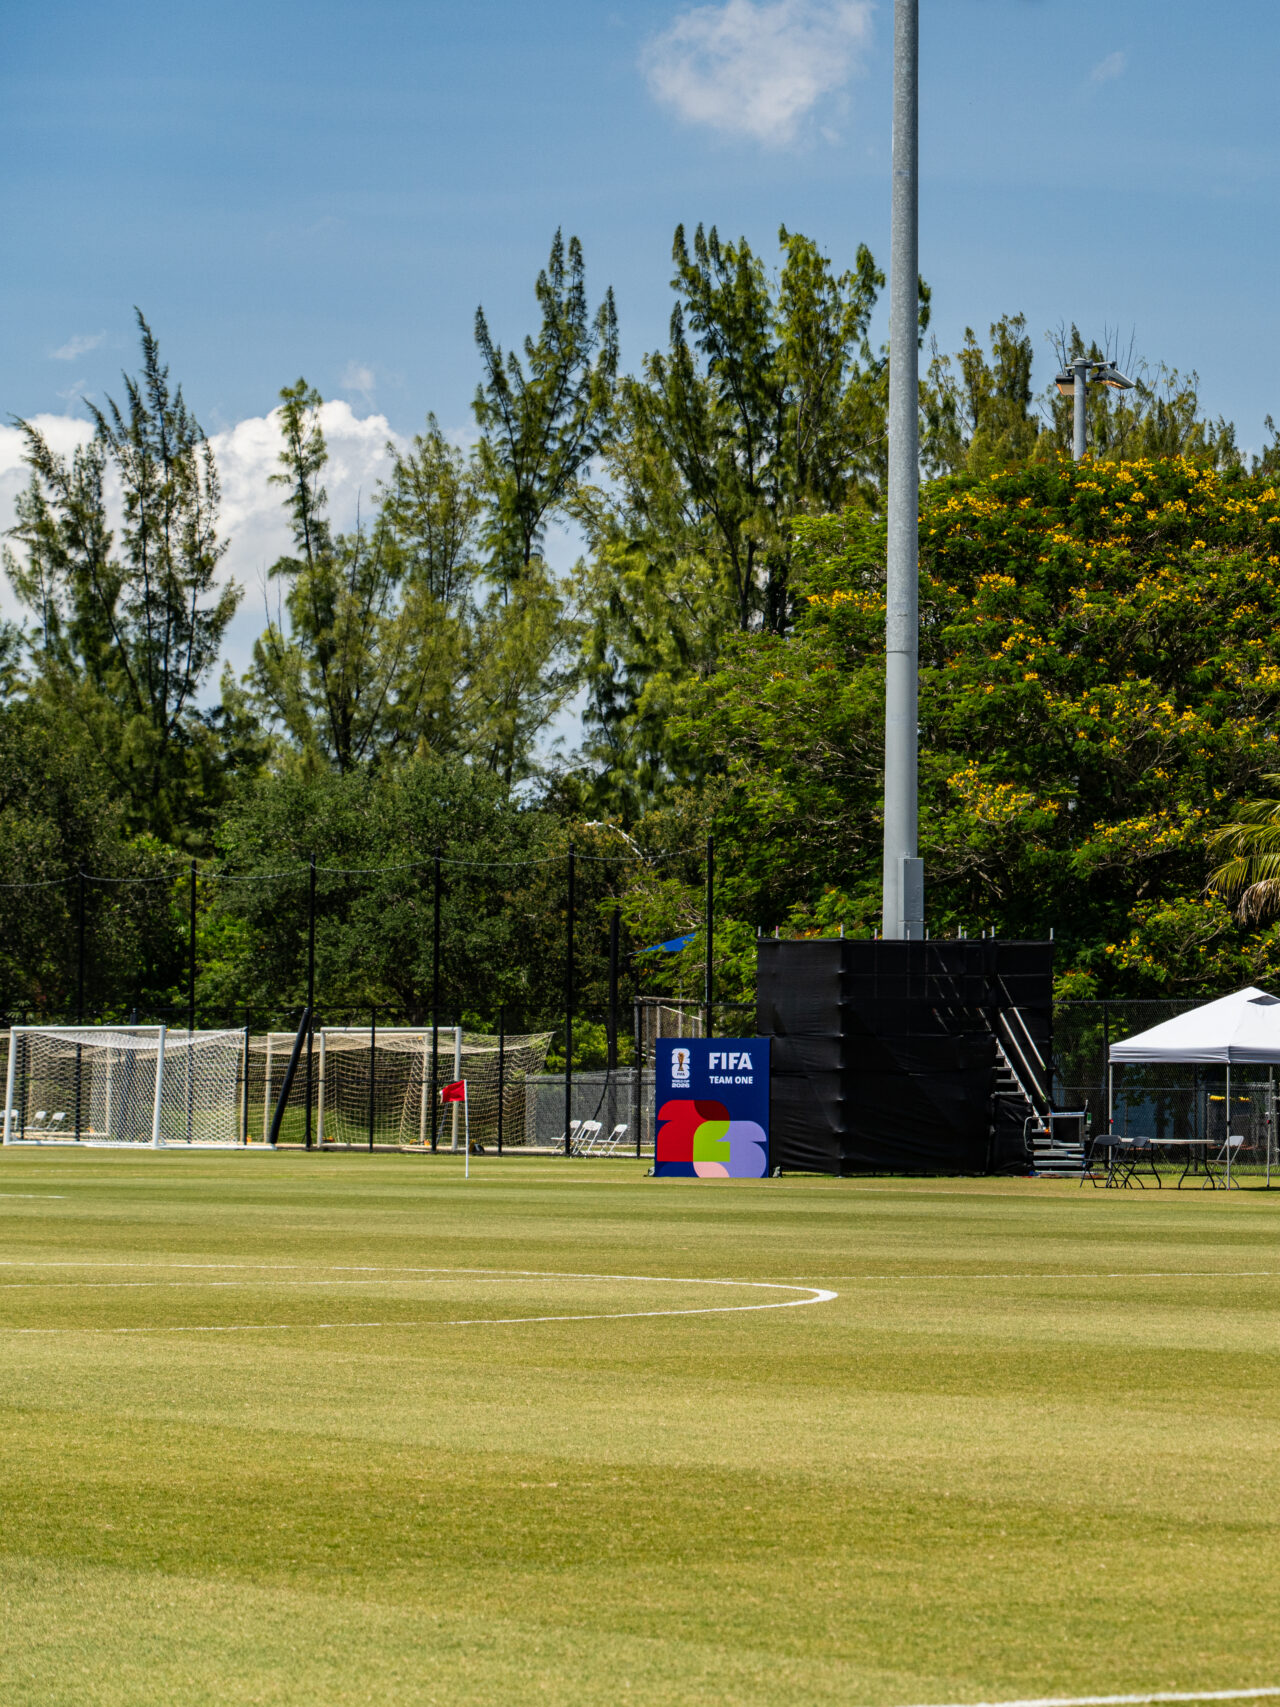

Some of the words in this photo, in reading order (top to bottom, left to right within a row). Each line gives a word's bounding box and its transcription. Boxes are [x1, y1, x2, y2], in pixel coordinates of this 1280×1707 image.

[709, 1052, 753, 1070] FIFA
[709, 1076, 733, 1084] TEAM
[735, 1076, 753, 1084] ONE
